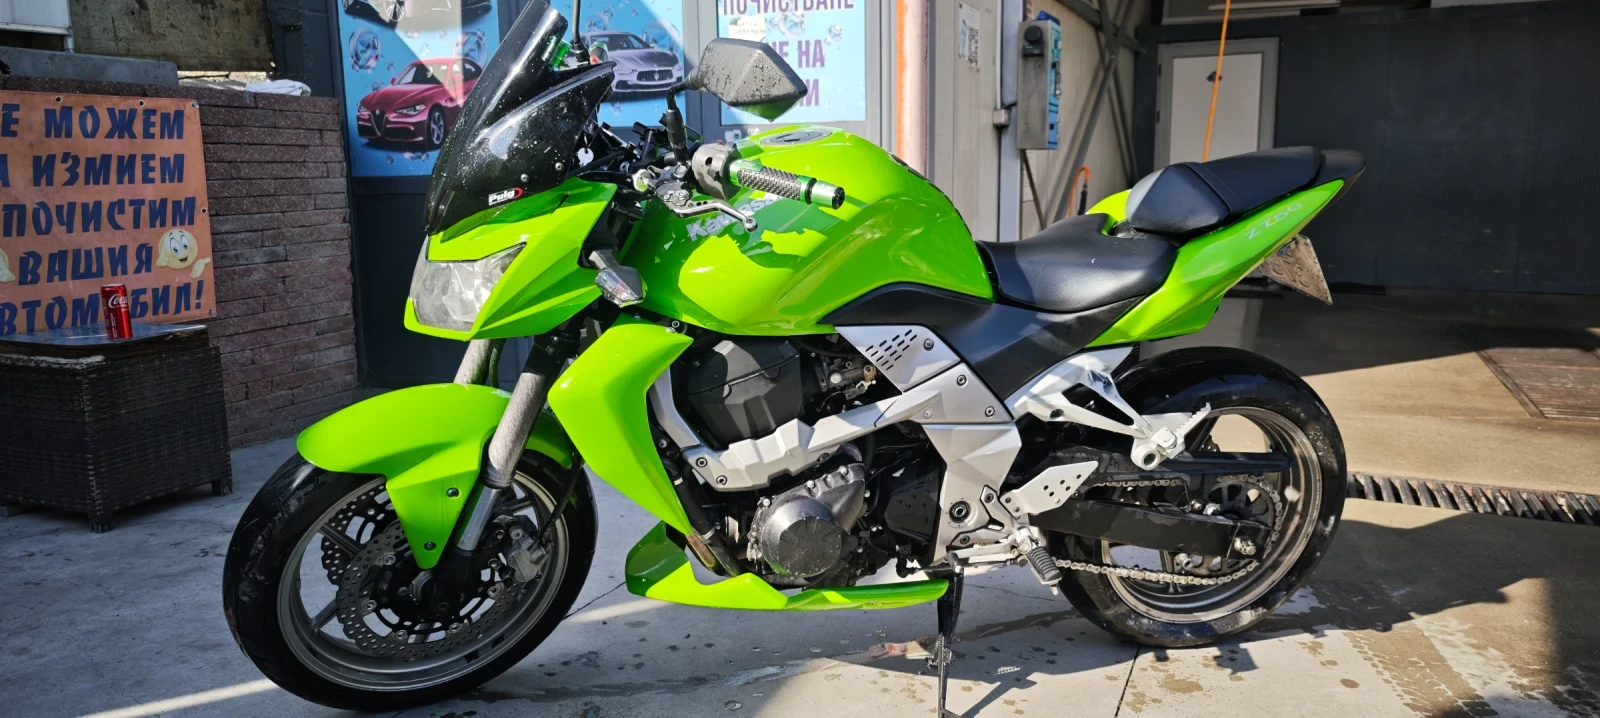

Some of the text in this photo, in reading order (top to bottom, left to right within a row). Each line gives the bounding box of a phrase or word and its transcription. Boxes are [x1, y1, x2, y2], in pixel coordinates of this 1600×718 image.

[797, 39, 825, 69] НА
[44, 105, 184, 139] МОЖЕМ
[33, 152, 185, 187] ИЗМИЕМ
[489, 190, 516, 204] Puig
[3, 197, 196, 237] ПОЧИСТИМ
[19, 243, 153, 286] ВАШИЯ
[0, 280, 204, 336] ВТОМБИЛ!
